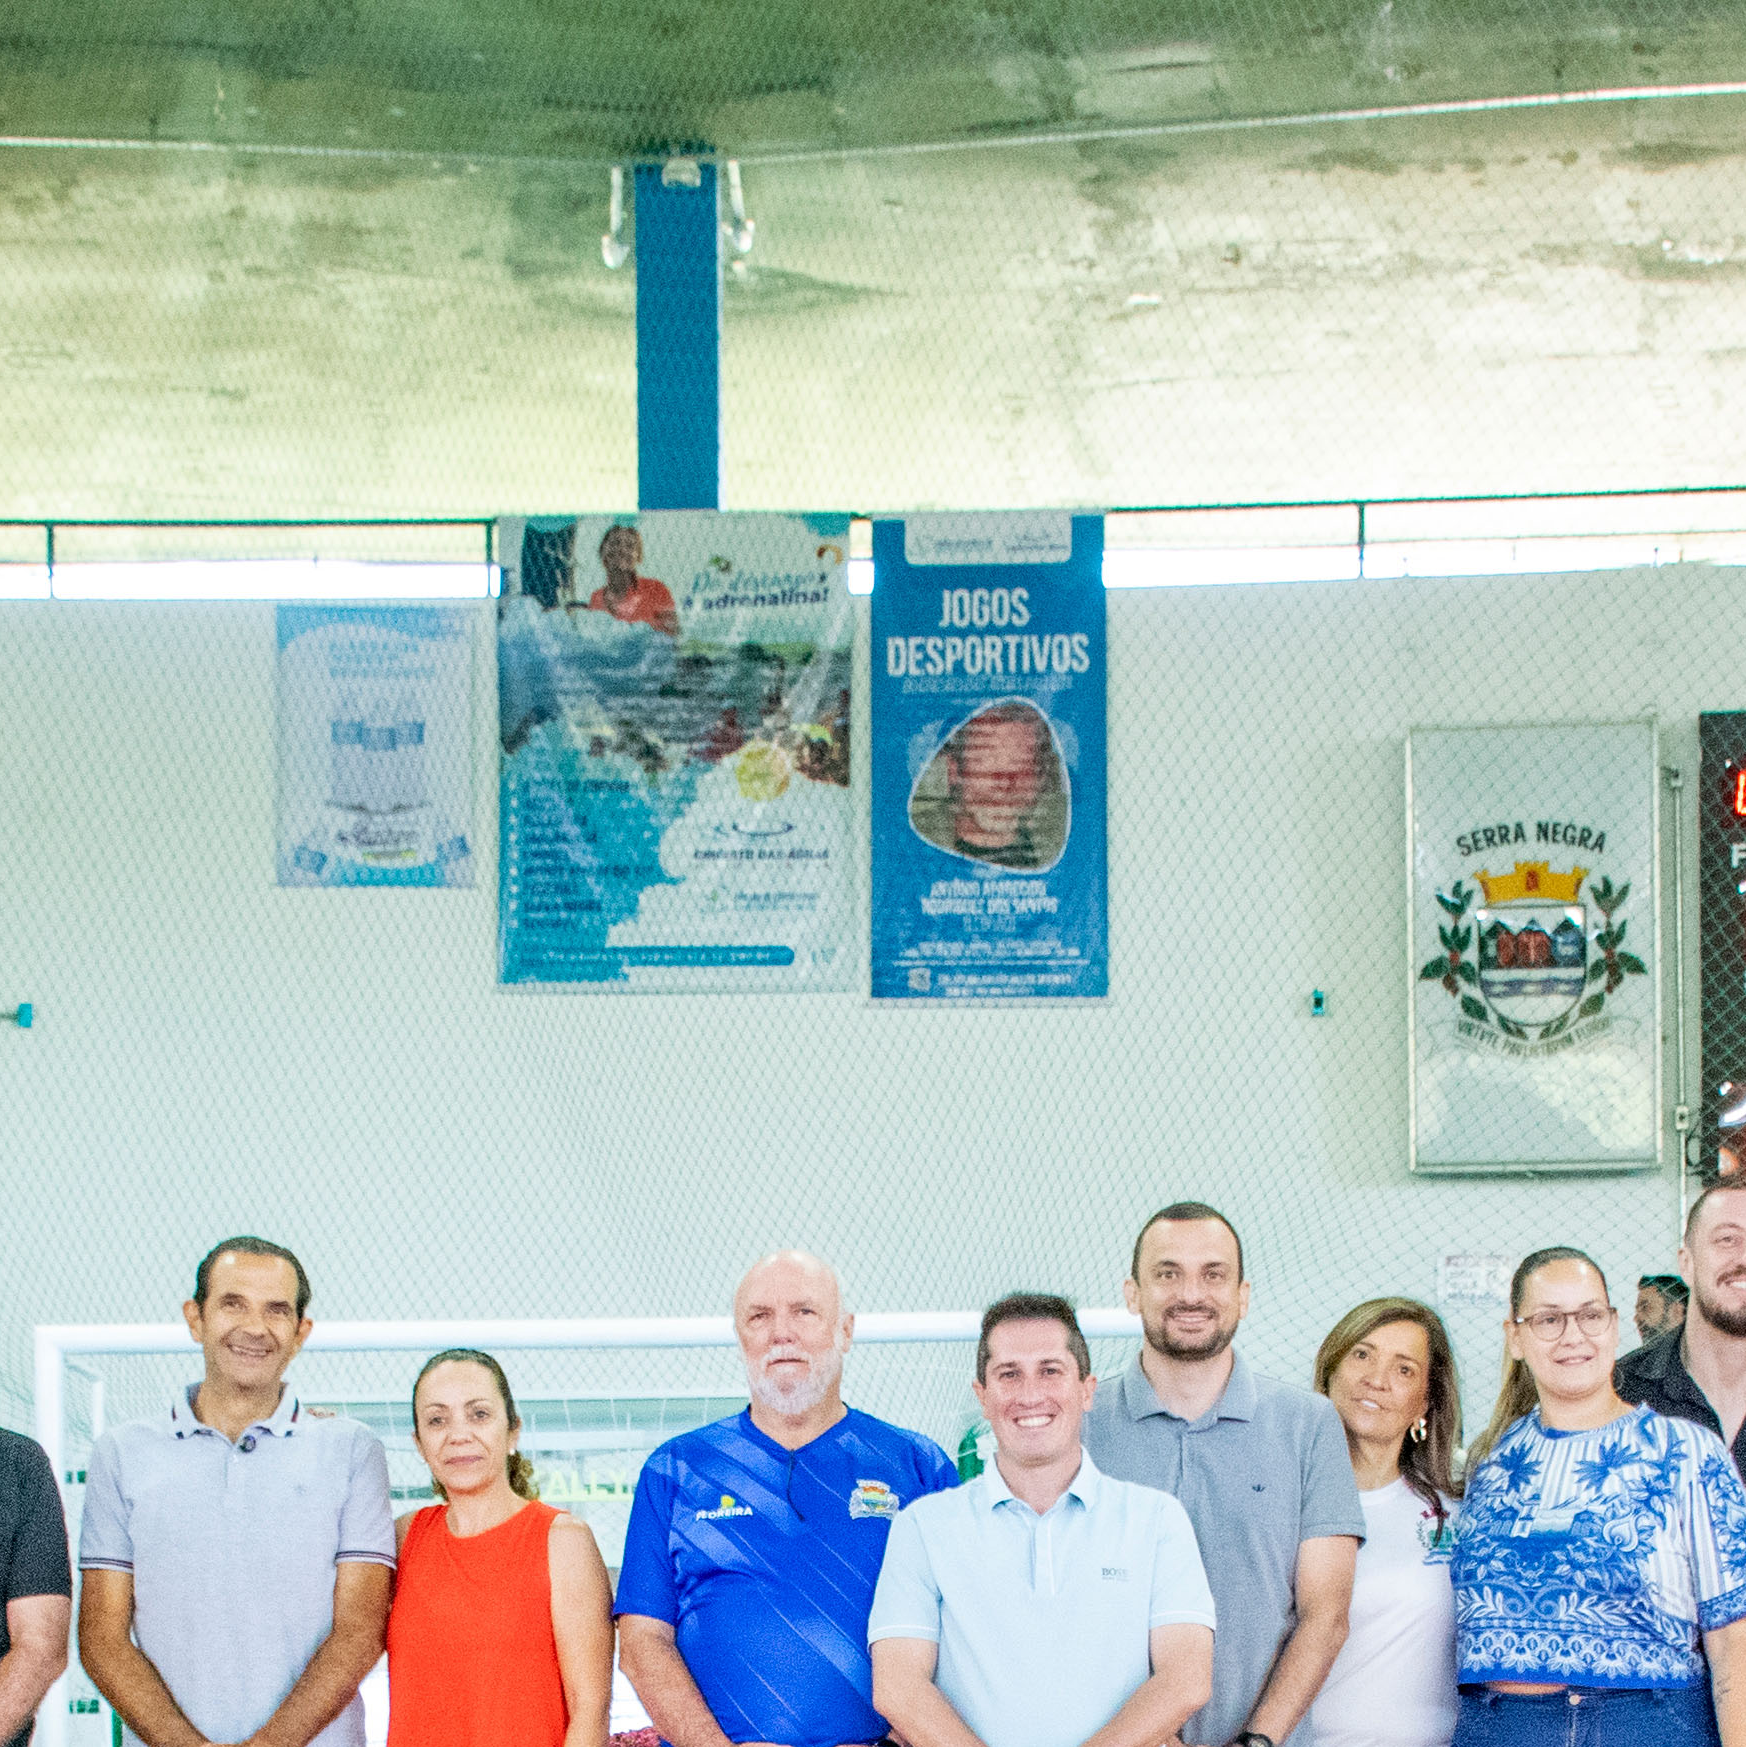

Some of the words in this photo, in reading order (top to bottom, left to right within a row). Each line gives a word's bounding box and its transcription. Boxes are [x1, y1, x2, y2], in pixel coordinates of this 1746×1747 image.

[938, 586, 1031, 628] JOGOS
[886, 632, 1090, 678] DESPORTIVOS
[1456, 821, 1527, 857] SERRA
[1535, 821, 1607, 853] NEGRA
